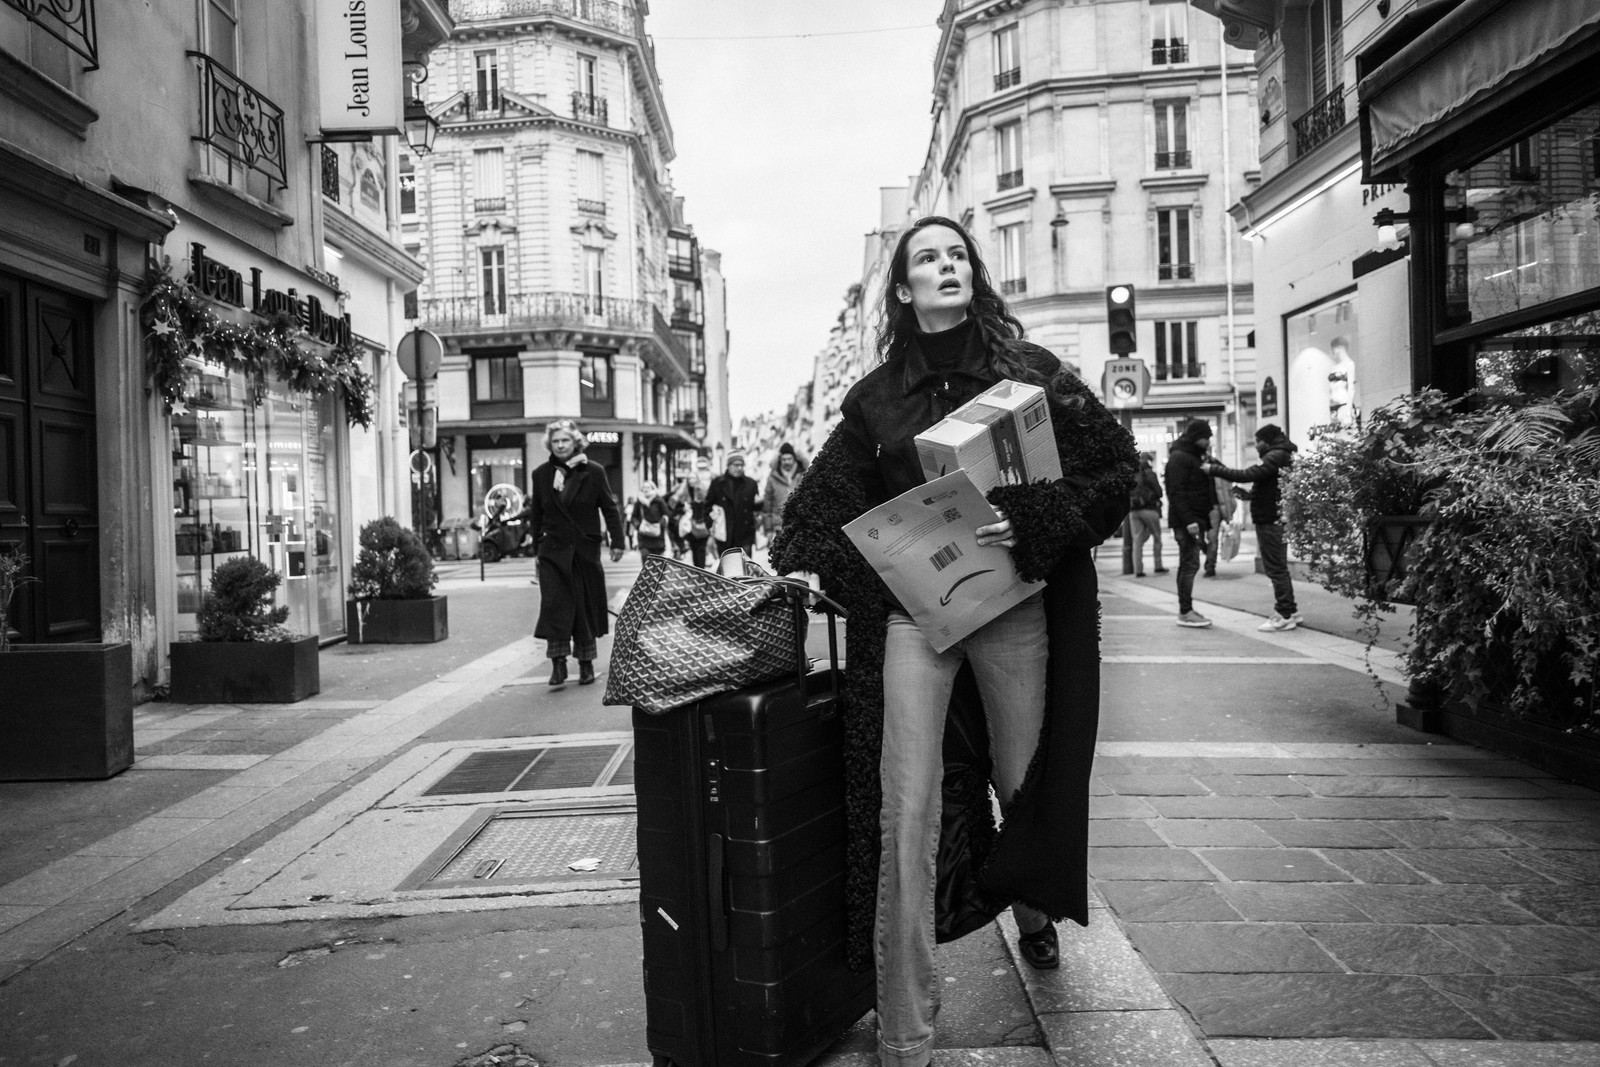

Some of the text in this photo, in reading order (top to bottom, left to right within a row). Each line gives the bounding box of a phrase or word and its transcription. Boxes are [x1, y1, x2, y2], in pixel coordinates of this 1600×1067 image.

[343, 0, 371, 117] Jean Louis
[188, 242, 245, 307] Jean
[250, 267, 303, 326] Louis
[306, 294, 351, 348] David
[1112, 364, 1137, 373] ZONE
[586, 432, 619, 443] GUESS
